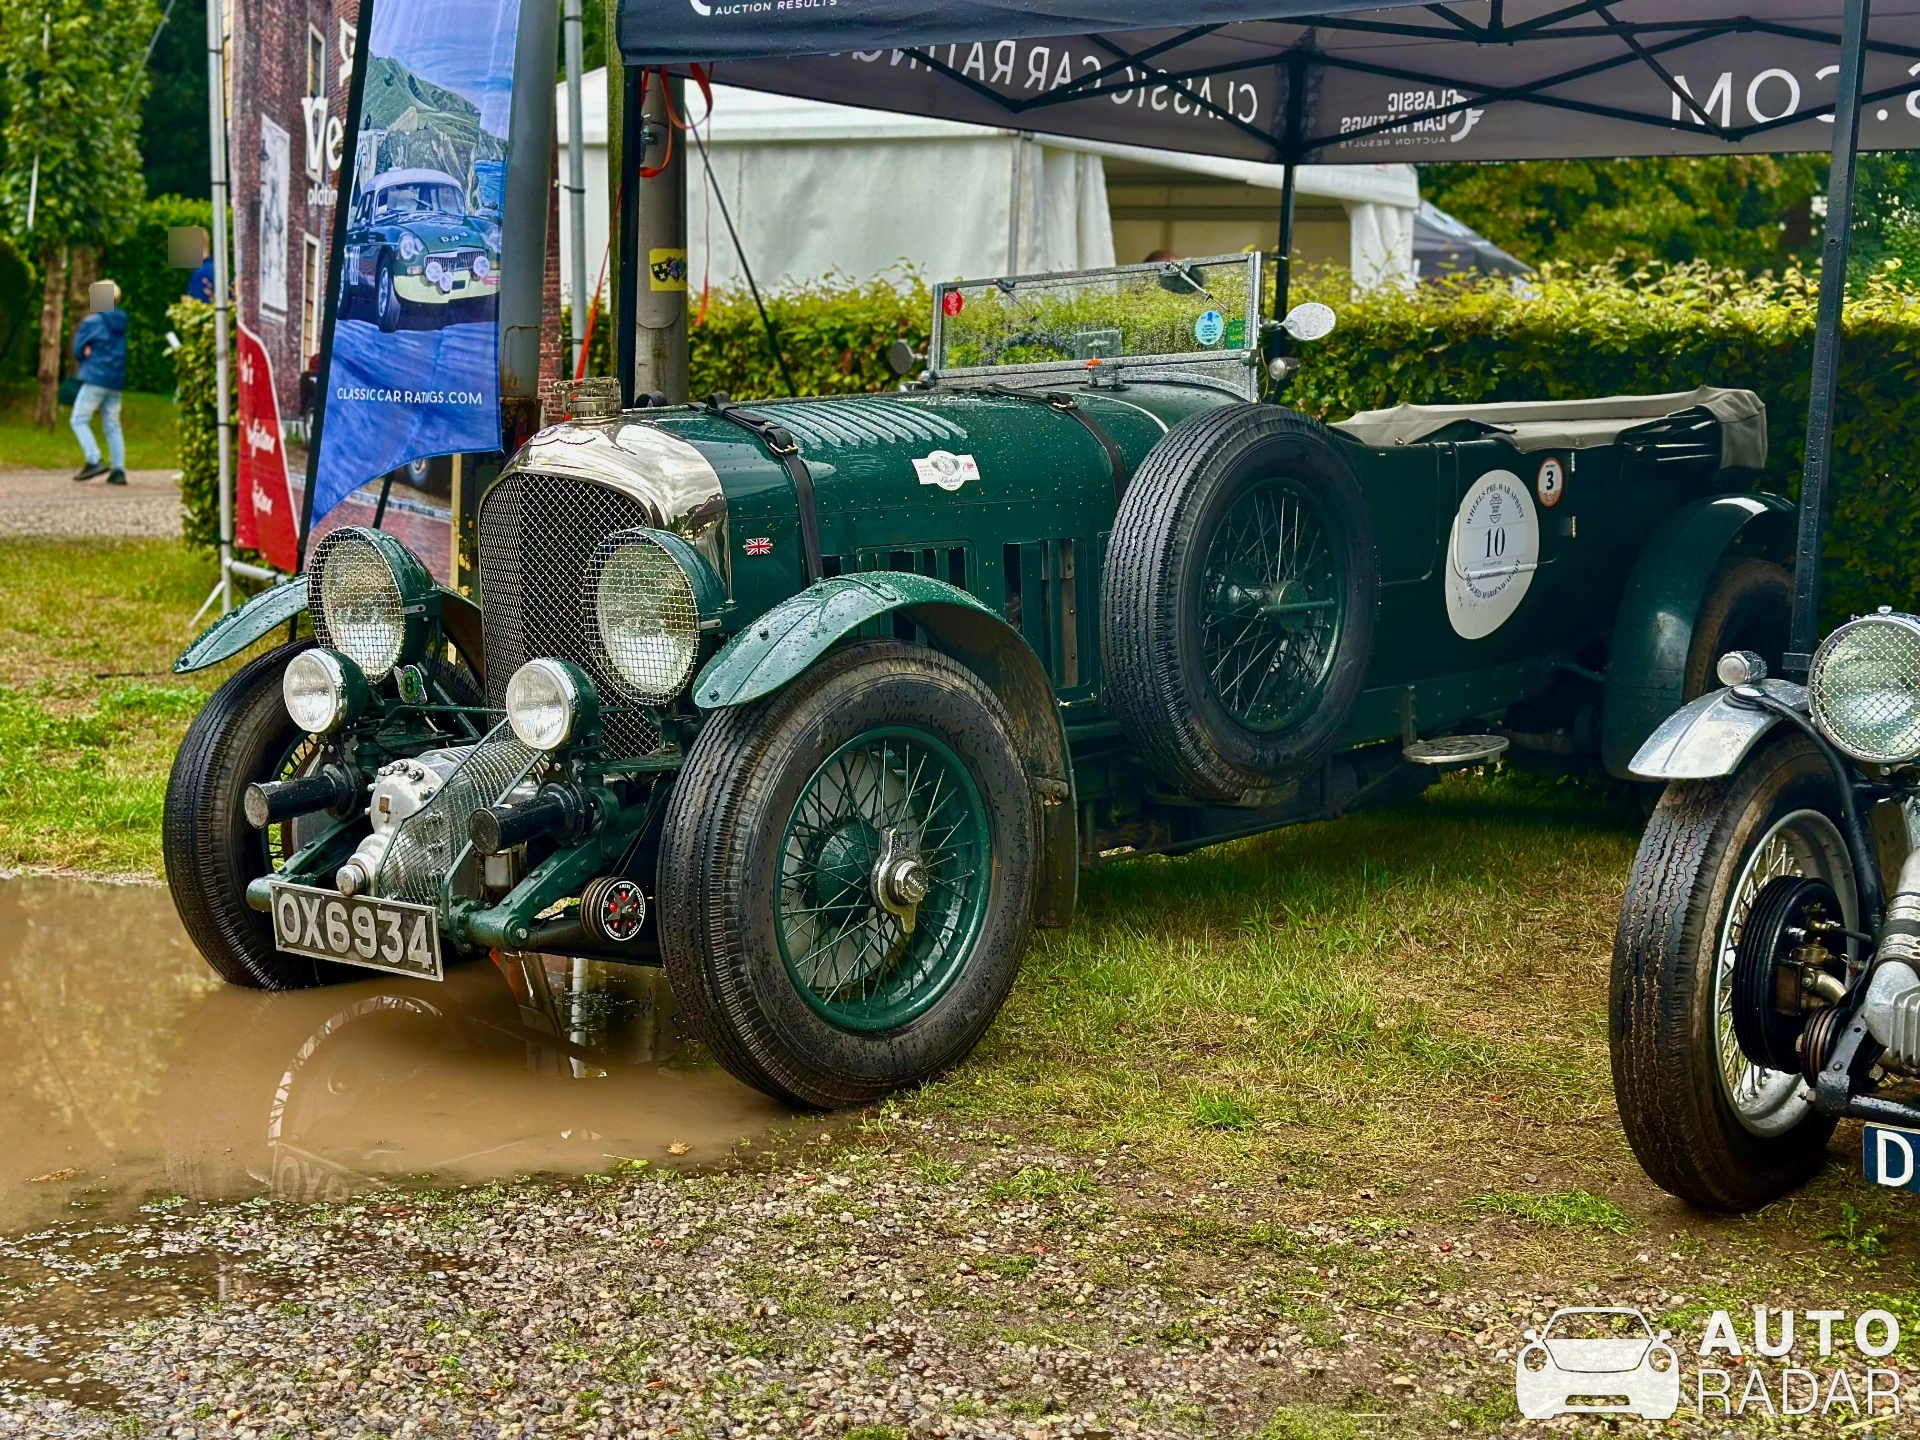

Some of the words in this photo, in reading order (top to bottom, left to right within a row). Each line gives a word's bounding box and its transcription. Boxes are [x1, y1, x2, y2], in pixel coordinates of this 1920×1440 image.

[715, 3, 772, 16] AUCTION
[1546, 470, 1554, 490] 3
[1484, 526, 1506, 559] 10
[278, 893, 433, 970] OX6934
[1876, 1129, 1914, 1187] D
